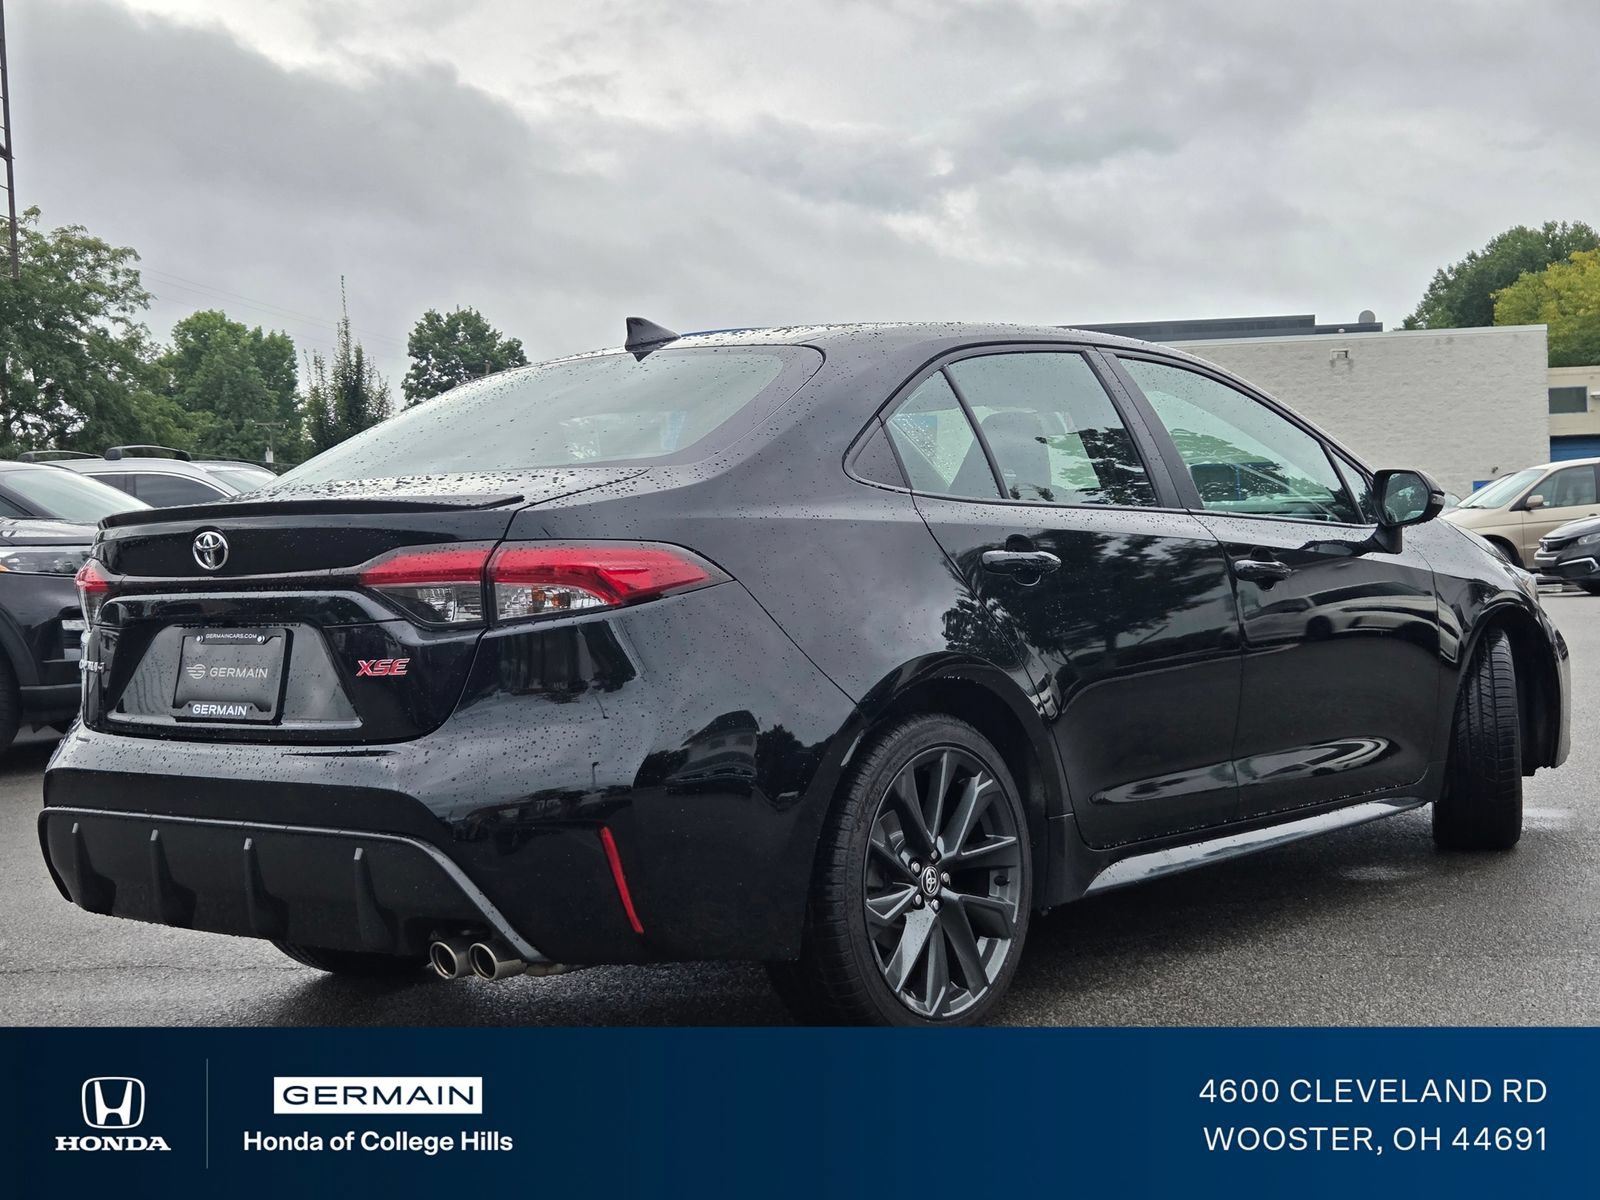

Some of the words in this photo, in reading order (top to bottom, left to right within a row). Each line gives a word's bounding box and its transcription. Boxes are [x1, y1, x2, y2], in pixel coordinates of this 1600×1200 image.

[209, 667, 269, 679] GERMAIN
[356, 657, 411, 677] XSE
[192, 704, 248, 716] GERMAIN
